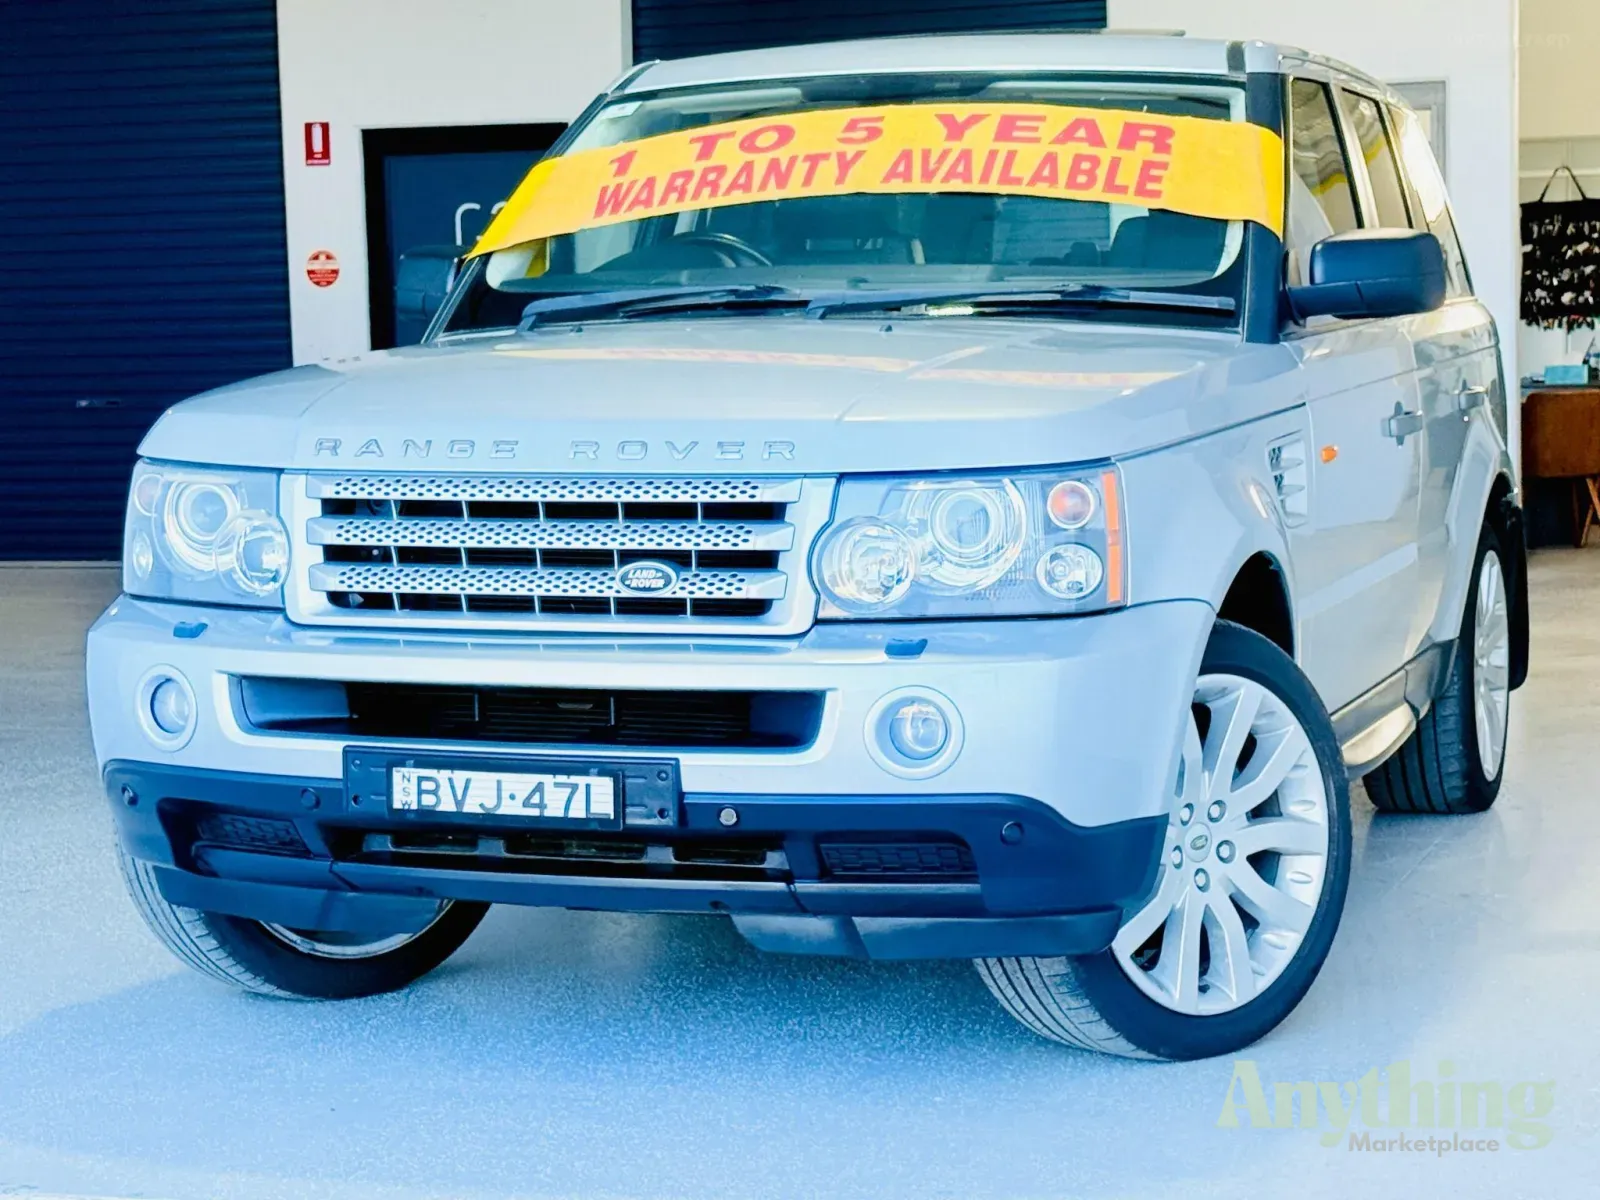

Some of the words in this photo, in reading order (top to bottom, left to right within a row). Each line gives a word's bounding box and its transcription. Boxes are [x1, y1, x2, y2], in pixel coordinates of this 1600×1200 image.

[609, 150, 638, 178] 1
[688, 124, 796, 163] TO
[836, 116, 886, 145] 5
[934, 113, 1176, 155] YEAR
[593, 150, 867, 219] WARRANTY
[880, 148, 1170, 199] AVAILABLE
[313, 438, 519, 459] RANGE
[568, 440, 796, 460] ROVER
[628, 569, 657, 579] LAND
[630, 579, 665, 589] ROVER
